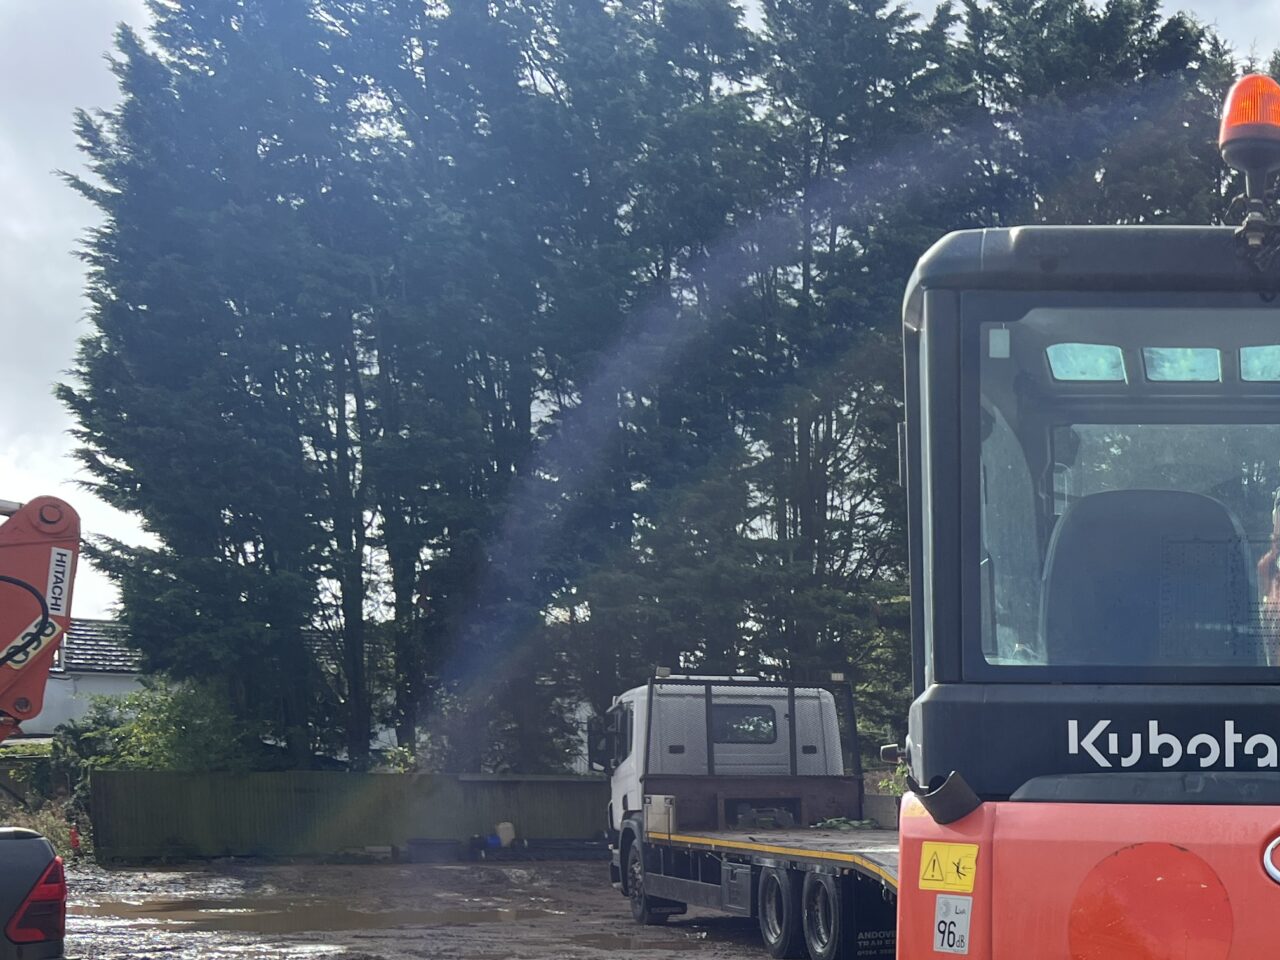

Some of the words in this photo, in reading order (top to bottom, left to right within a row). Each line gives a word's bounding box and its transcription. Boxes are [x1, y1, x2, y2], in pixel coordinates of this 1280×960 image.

[50, 552, 68, 612] HITACHI
[1067, 719, 1278, 768] Kubota
[937, 920, 956, 948] 96
